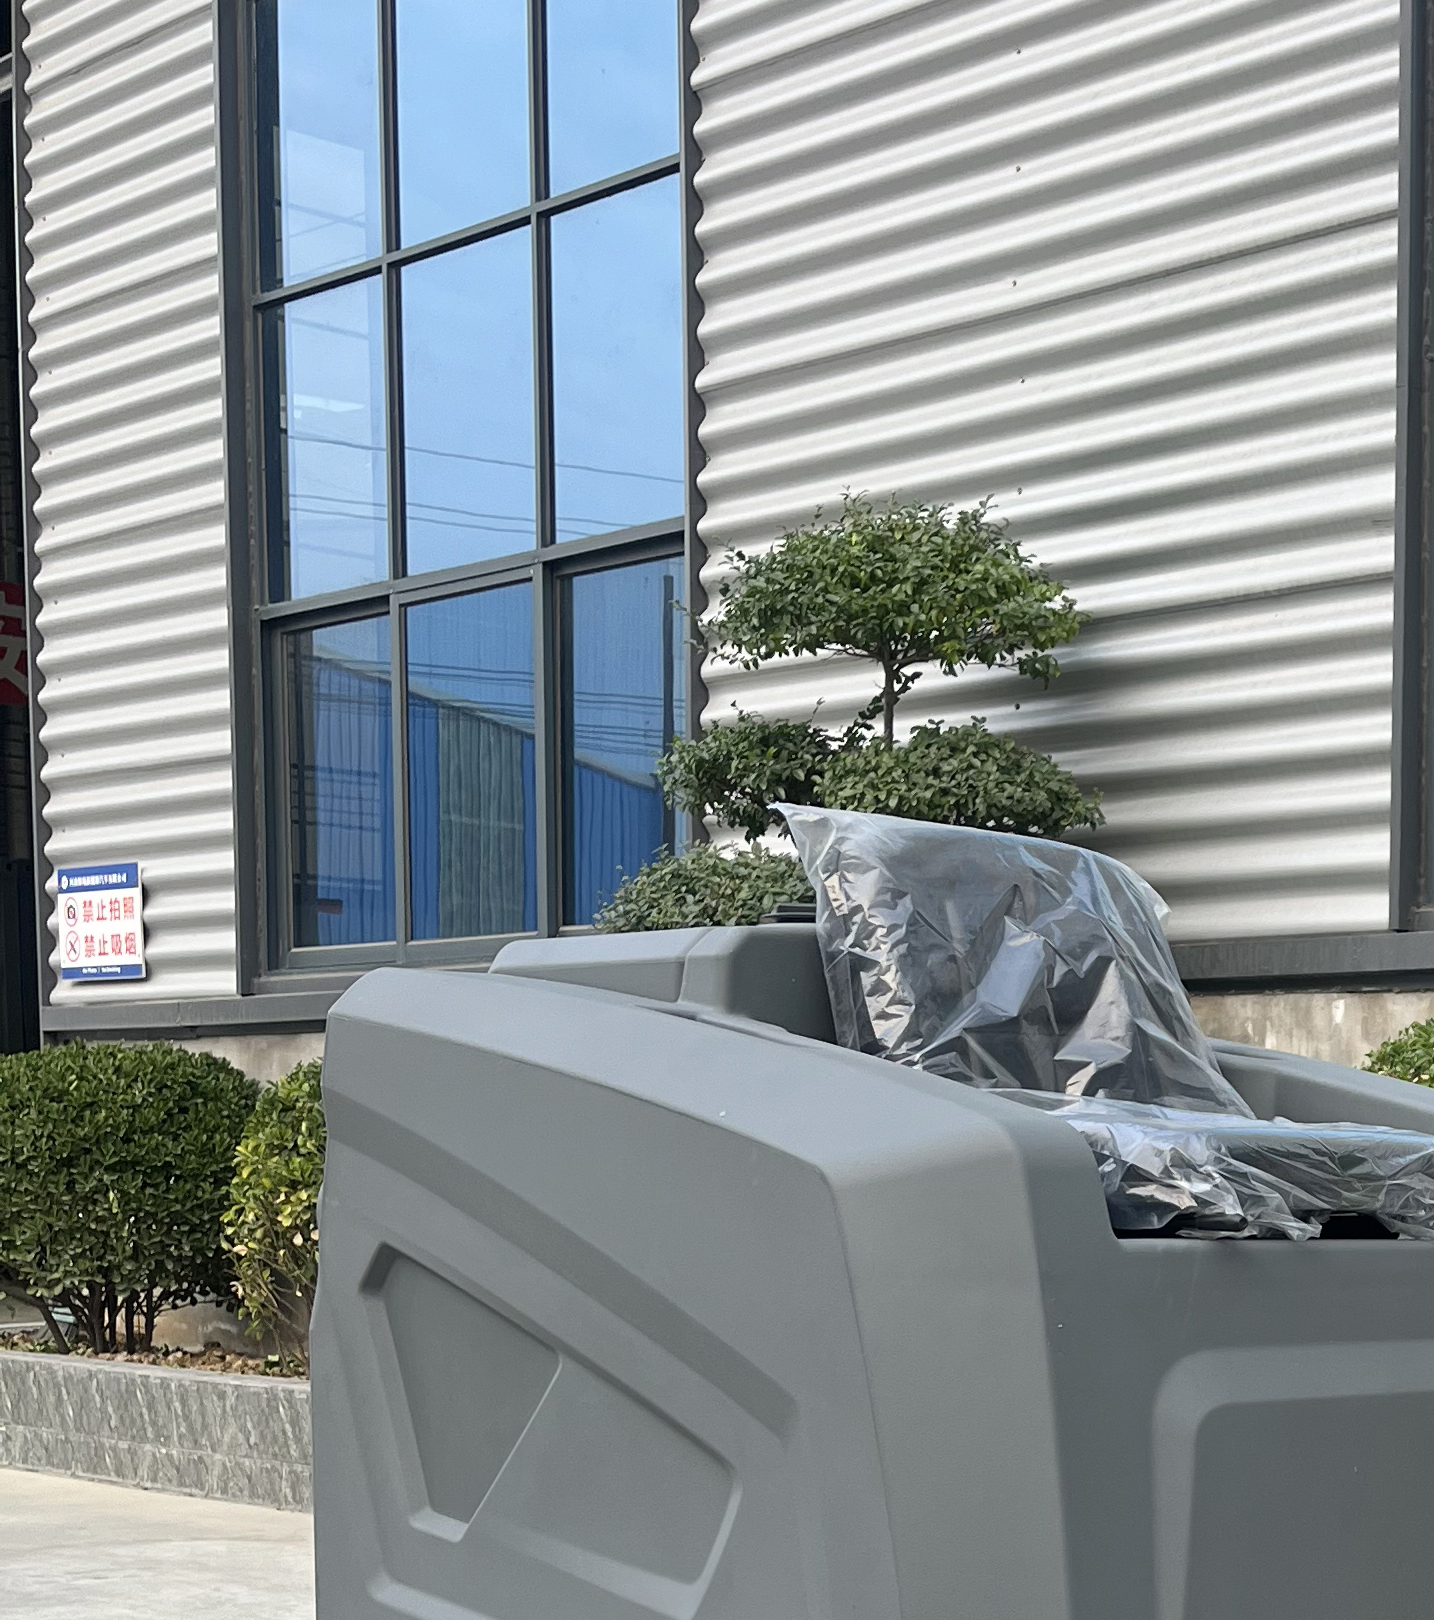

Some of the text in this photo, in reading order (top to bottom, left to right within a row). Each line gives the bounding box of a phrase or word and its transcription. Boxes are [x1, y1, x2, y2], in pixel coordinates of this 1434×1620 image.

[83, 896, 135, 923] 禁止拍照
[84, 932, 137, 958] 禁止吸烟
